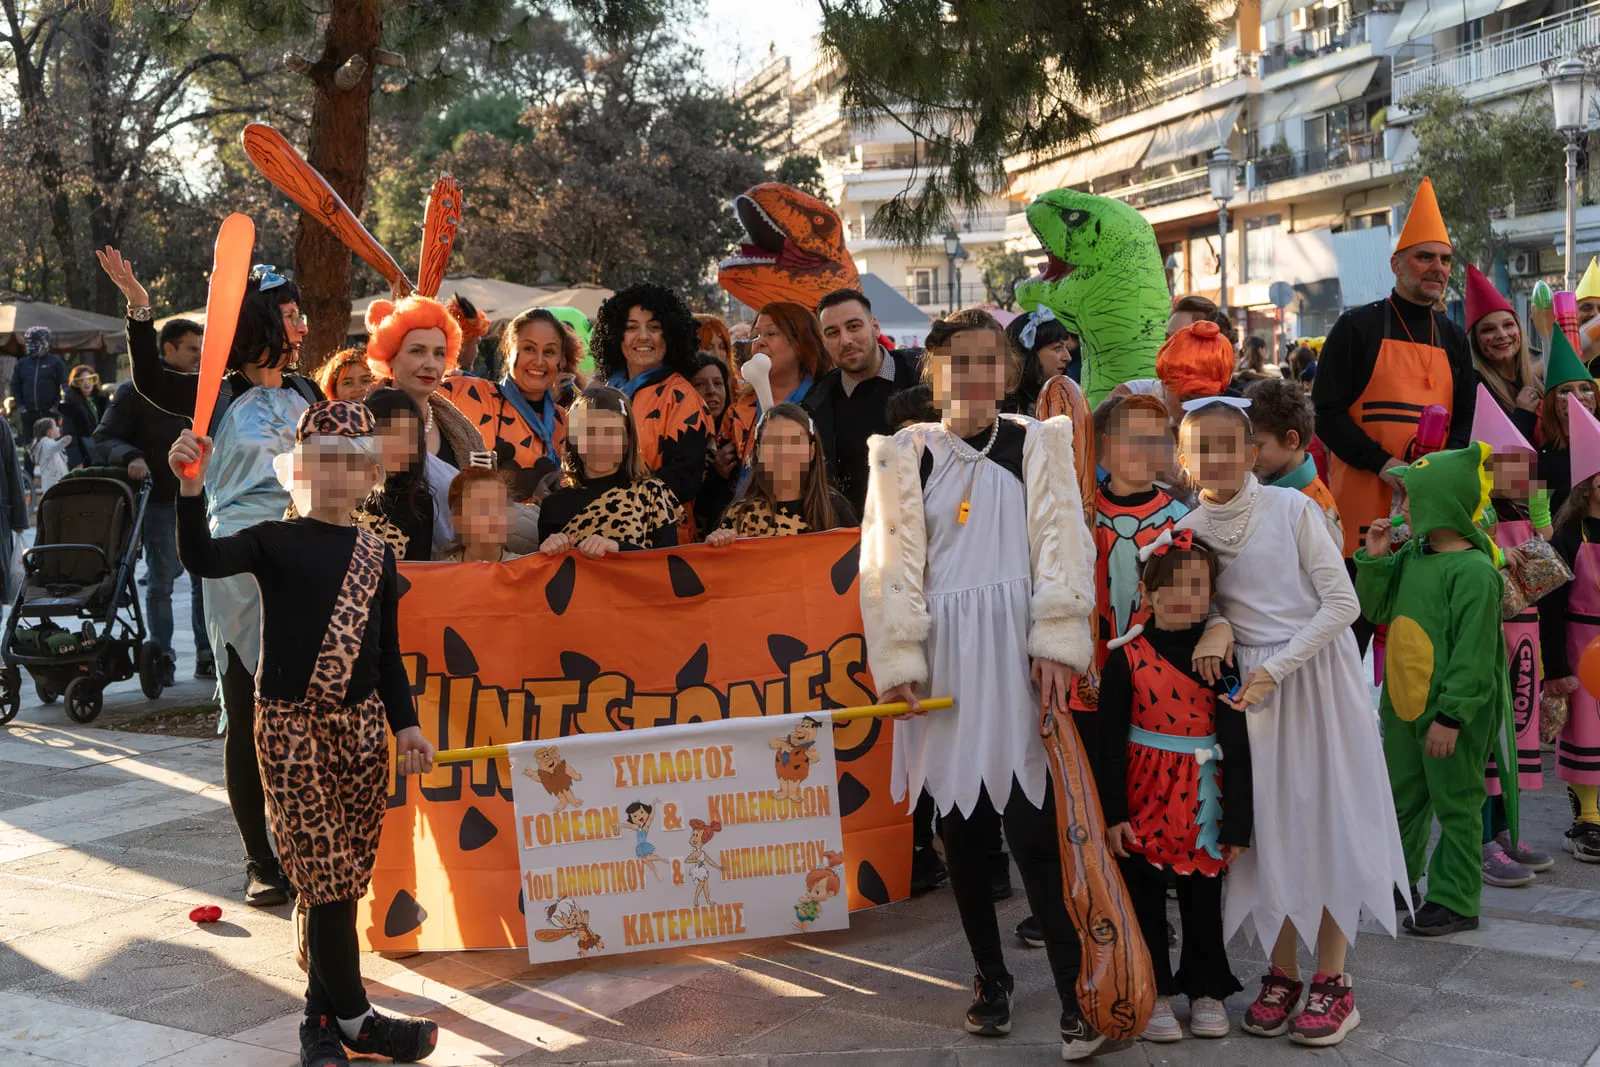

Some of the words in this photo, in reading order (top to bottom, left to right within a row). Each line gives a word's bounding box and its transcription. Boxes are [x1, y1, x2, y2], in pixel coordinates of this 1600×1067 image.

[1513, 643, 1532, 727] CRAYON
[386, 634, 882, 808] LINTSTES
[615, 745, 736, 788] ΣΥΛΛΟΓΟΣ
[522, 805, 620, 847] ΓΟΝΕΩΝ
[663, 803, 682, 830] &
[708, 785, 831, 825] ΚΗΔΕΜΟΝΩΝ
[525, 871, 553, 901] 1ου
[557, 858, 646, 898] ΔΗΜΟΤΙΚΟΥ
[672, 859, 685, 886] &
[720, 840, 827, 881] ΝΗΠΙΑΓΩΓΕΙΟΥ
[623, 903, 746, 946] ΚΑΤΕΡΙΝΗΣ
